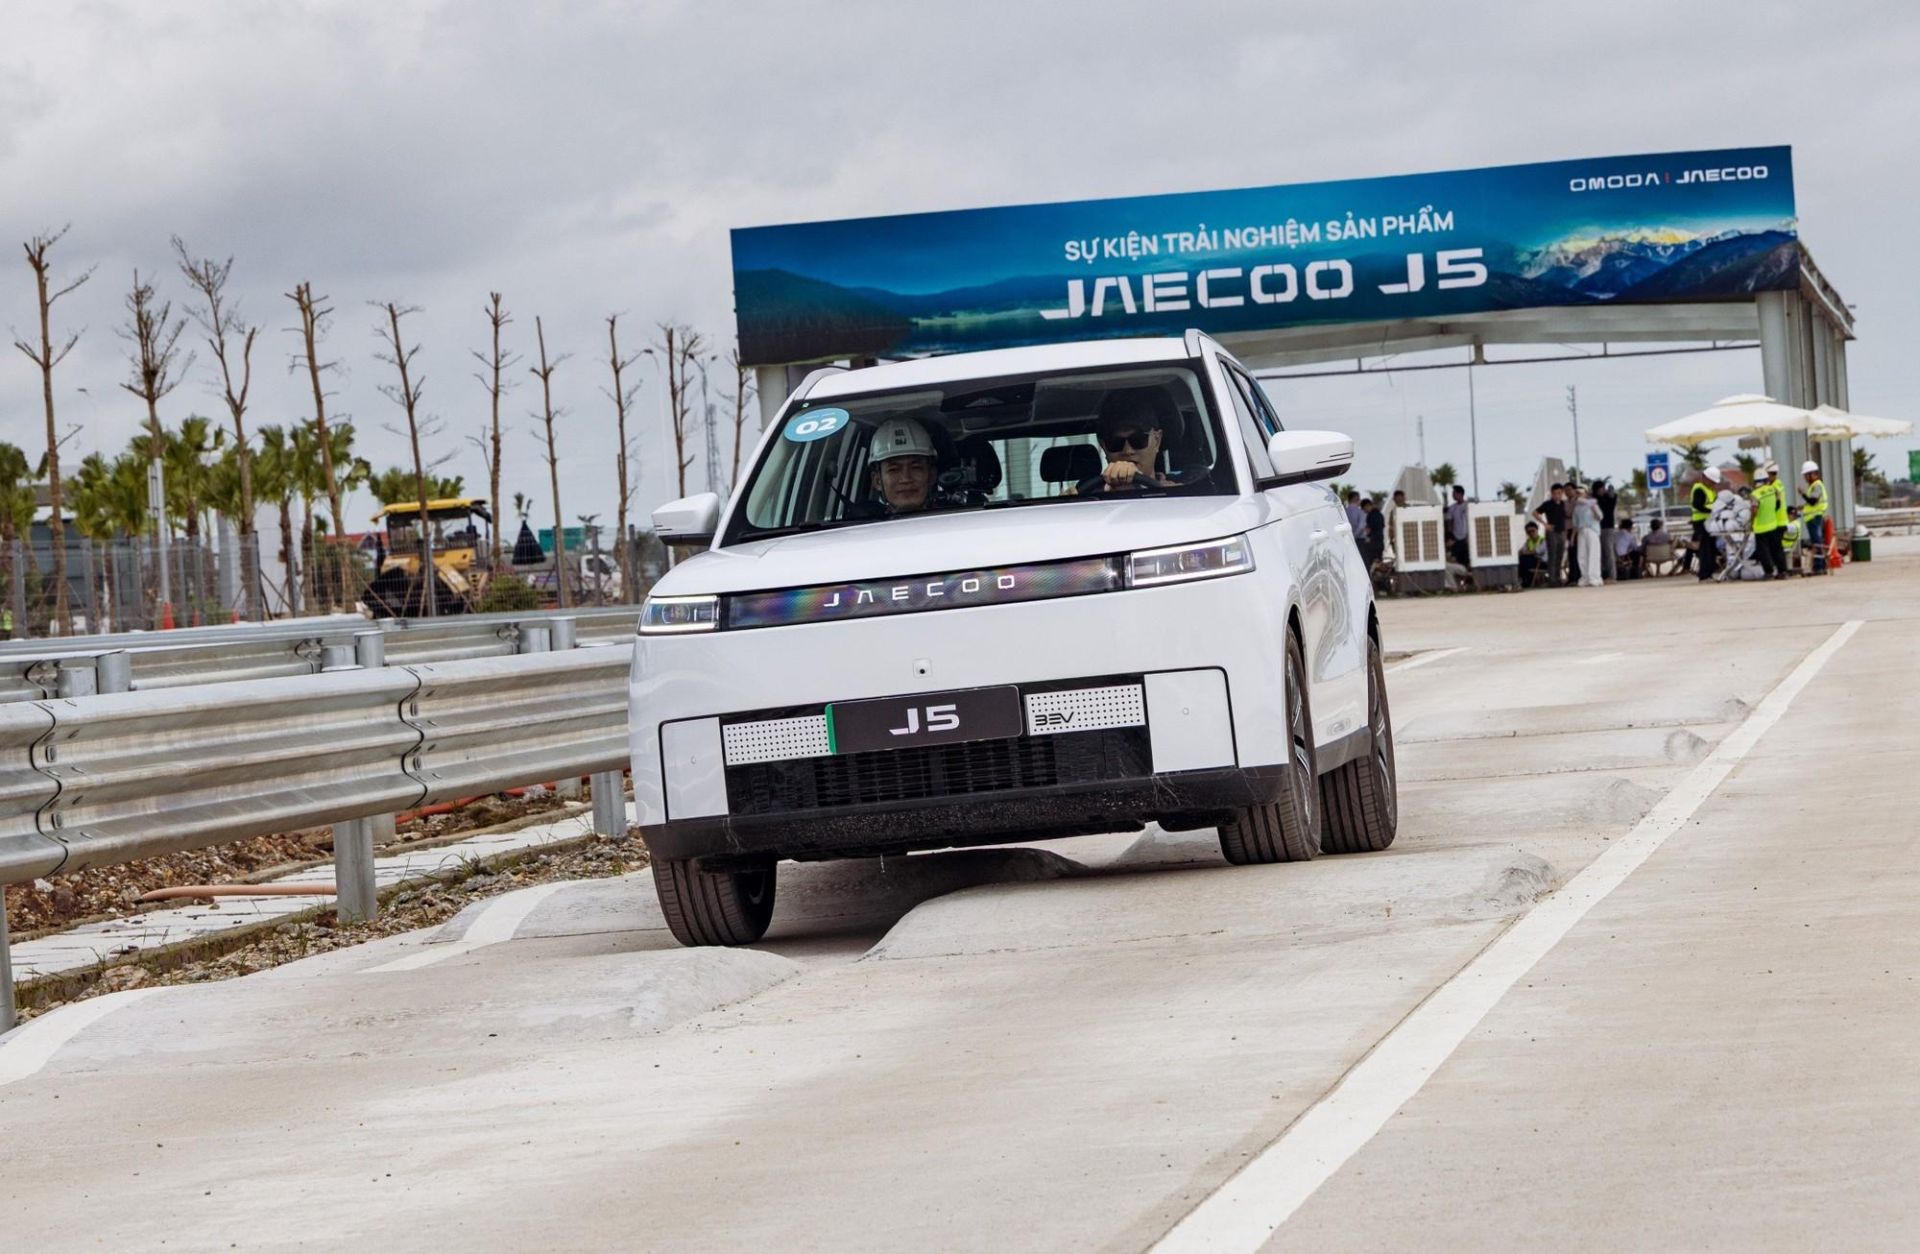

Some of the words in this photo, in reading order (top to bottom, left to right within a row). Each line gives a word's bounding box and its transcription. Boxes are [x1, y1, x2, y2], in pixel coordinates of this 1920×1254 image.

[1569, 172, 1660, 192] OMODA
[1675, 165, 1769, 185] JAECOO
[1064, 237, 1100, 265] SỰ
[1103, 230, 1159, 262] KIỆN
[1162, 222, 1218, 254] TRẢI
[1223, 217, 1321, 250] NGHIỆM
[1325, 210, 1377, 242] SẢN
[1382, 203, 1455, 237] PHẨM
[1039, 258, 1354, 320] JAECOO
[1377, 247, 1488, 295] J5
[795, 417, 838, 435] 02
[823, 575, 1016, 608] JAECOO
[888, 703, 960, 736] J5
[1034, 710, 1075, 727] BEV
